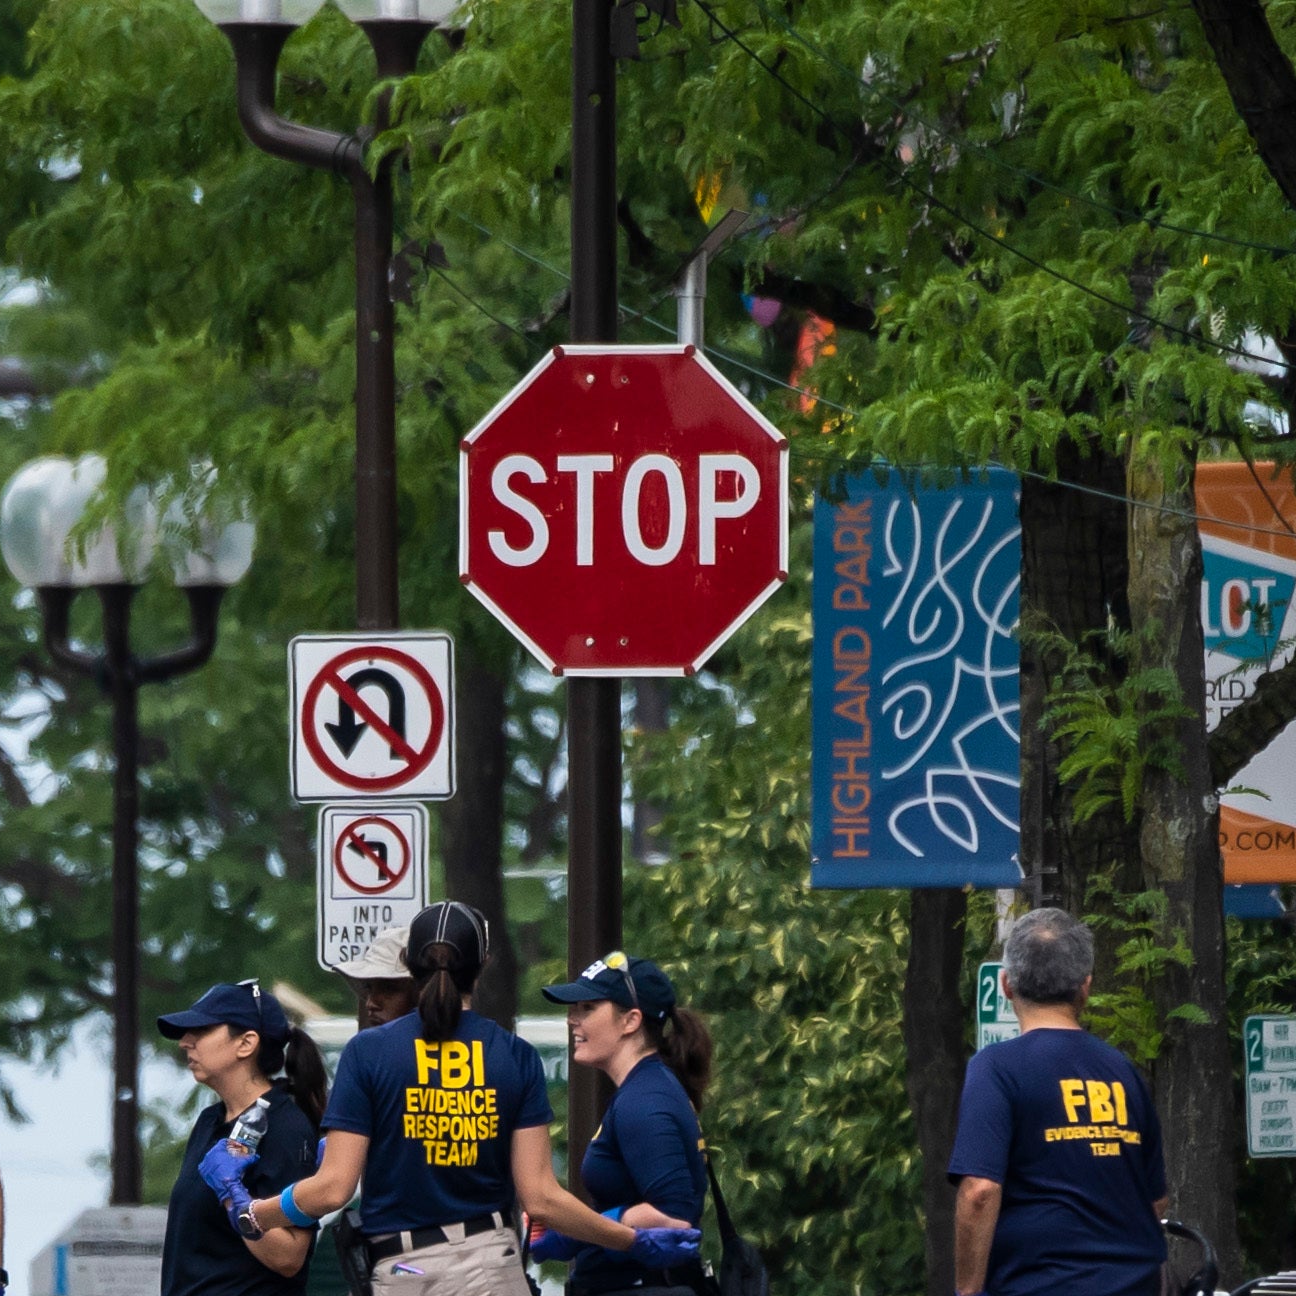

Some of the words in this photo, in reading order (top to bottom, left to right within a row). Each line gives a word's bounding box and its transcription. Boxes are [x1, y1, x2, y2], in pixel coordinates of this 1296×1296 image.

[488, 454, 761, 567] STOP
[832, 498, 872, 611] PARK
[831, 625, 872, 858] HIGHLAND
[353, 905, 392, 923] INTO
[329, 925, 387, 943] PARK
[981, 975, 995, 1012] 2
[1249, 1028, 1261, 1062] 2
[415, 1039, 484, 1088] FBI
[406, 1088, 496, 1115] EVIDENCE
[1060, 1079, 1127, 1126] FBI
[403, 1114, 499, 1141] RESPONSE
[1045, 1127, 1102, 1142] EVIDENCE
[423, 1141, 478, 1166] TEAM
[1090, 1142, 1120, 1156] TEAM
